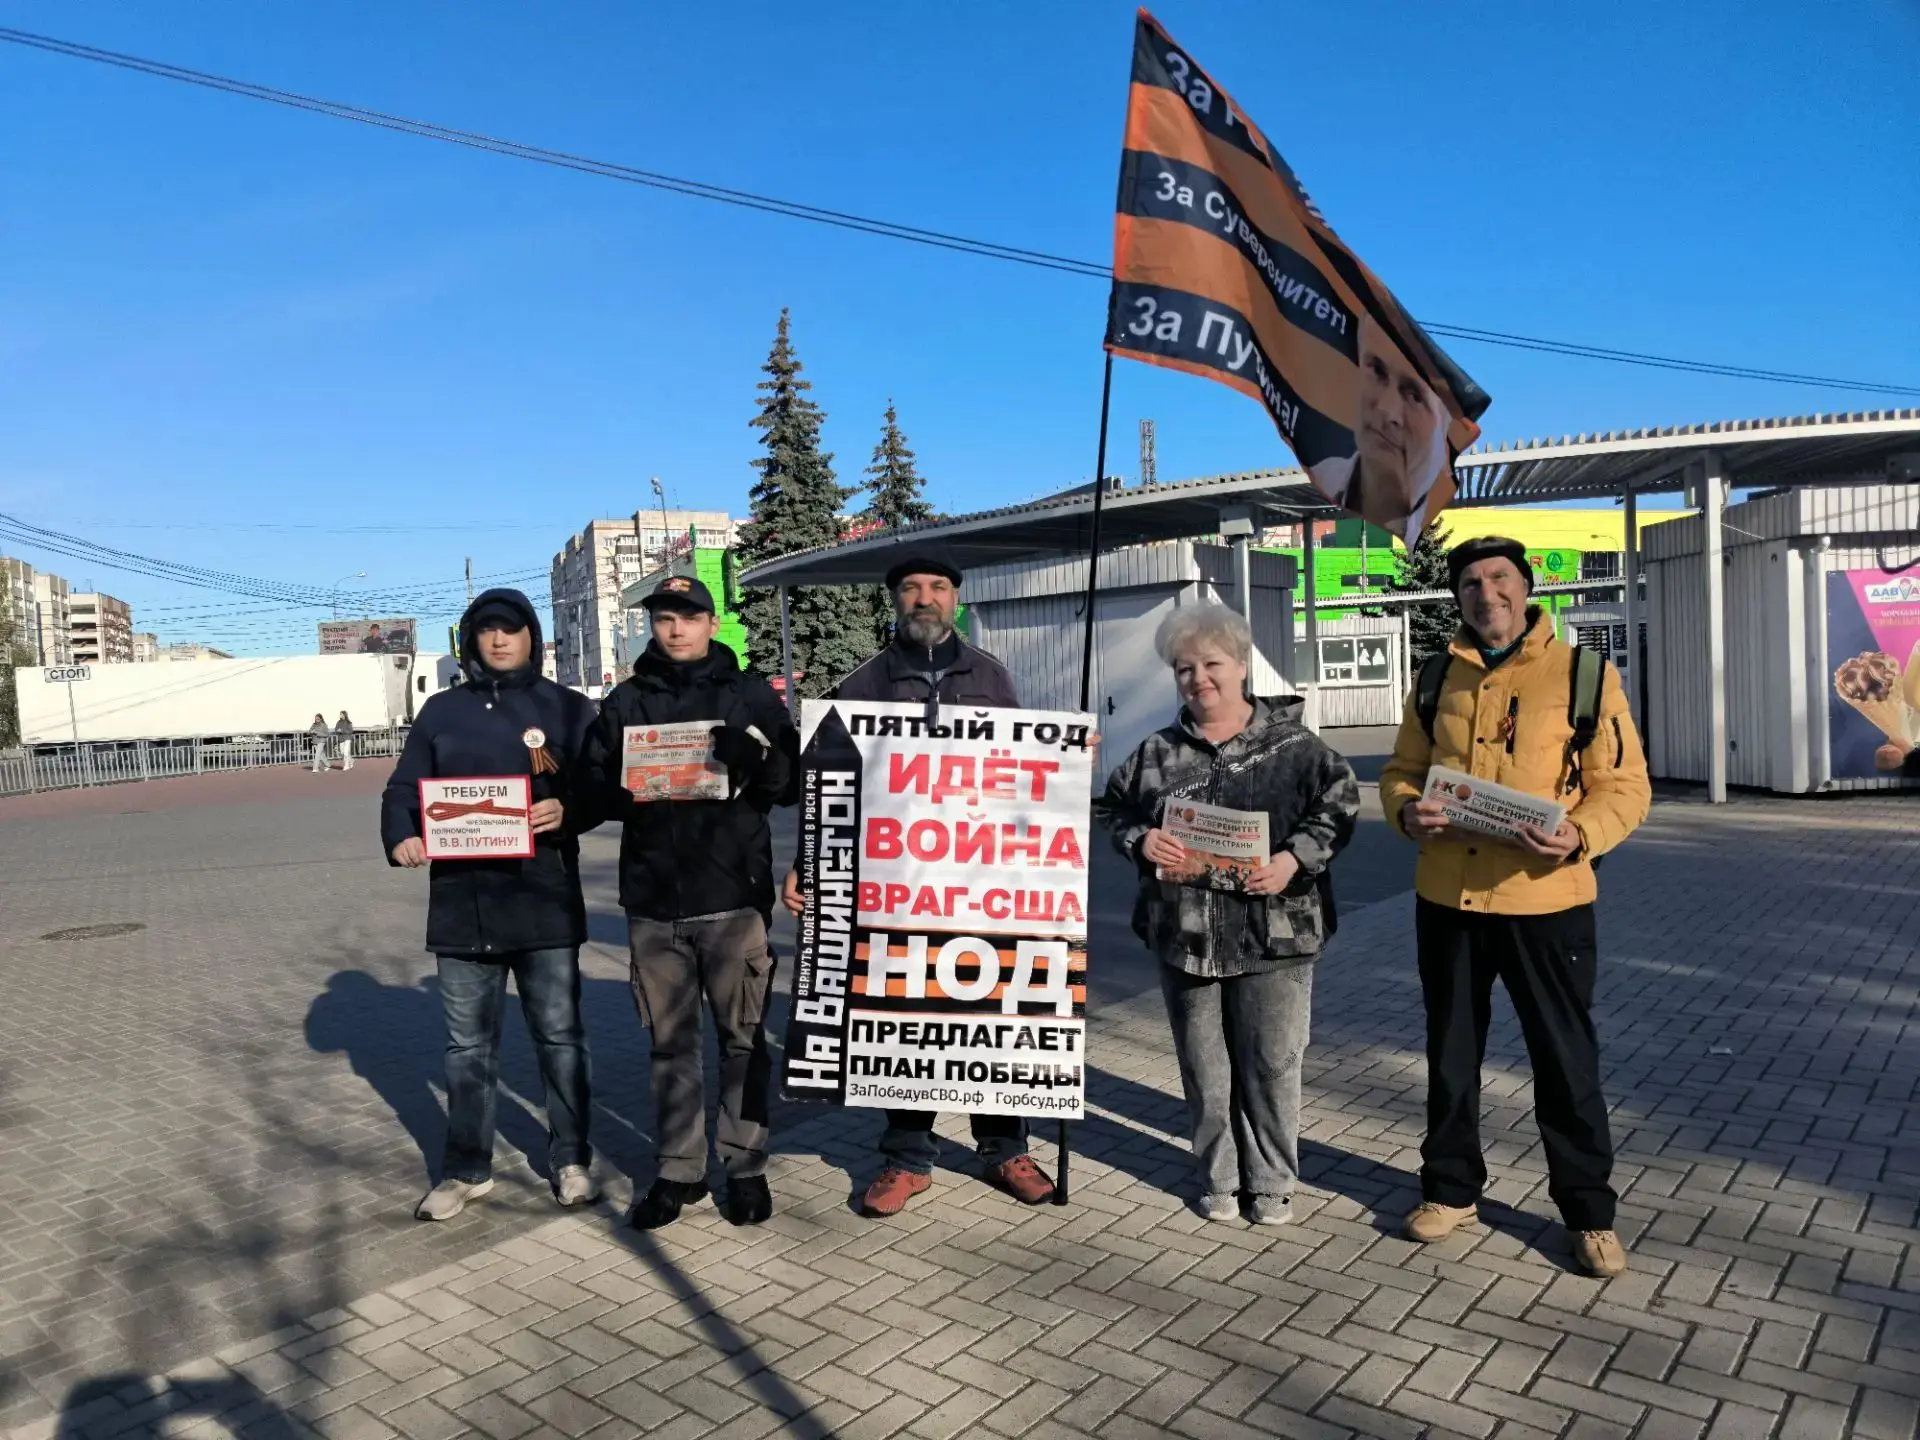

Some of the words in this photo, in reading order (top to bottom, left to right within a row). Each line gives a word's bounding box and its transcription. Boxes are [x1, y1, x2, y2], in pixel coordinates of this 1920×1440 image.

[1165, 51, 1213, 115] За
[1155, 172, 1194, 207] За
[1128, 296, 1183, 342] За
[49, 668, 86, 680] СТОП
[850, 710, 995, 741] ПЯТЫЙ
[1012, 721, 1089, 753] ГОД
[442, 785, 508, 798] ТРЕБУЕМ
[805, 769, 817, 789] РФ!
[888, 748, 1060, 807] ИДЁТ
[805, 792, 816, 820] РВСН
[1441, 806, 1463, 820] РОНТ
[1463, 814, 1497, 832] ВНУТРИ
[1472, 797, 1547, 827] СУВЕРЕНИТЕТ
[439, 837, 463, 848] В.В.
[466, 836, 519, 848] ПУТИНУ!
[865, 812, 1086, 869] ВОЙНА
[1193, 832, 1222, 846] ВНУТРИ
[1222, 839, 1253, 849] СТРАНЫ
[1196, 818, 1260, 833] СУВЕРЕНИТЕТ
[803, 834, 815, 884] ЗАДАНИЯ
[801, 887, 815, 944] ПОЛЁТНЫЕ
[857, 881, 1085, 923] ВРАГ-США
[798, 945, 813, 997] ВЕРНУТЬ
[865, 932, 1073, 1017] НОД
[850, 1018, 1082, 1051] ПРЕДЛАГАЕТ
[849, 1054, 935, 1080] ПЛАН
[945, 1059, 1081, 1090] ПОБЕДЫ
[849, 1083, 985, 1106] ЗаПобедувСВО.рф
[995, 1091, 1080, 1111] Горбсуд.рф
